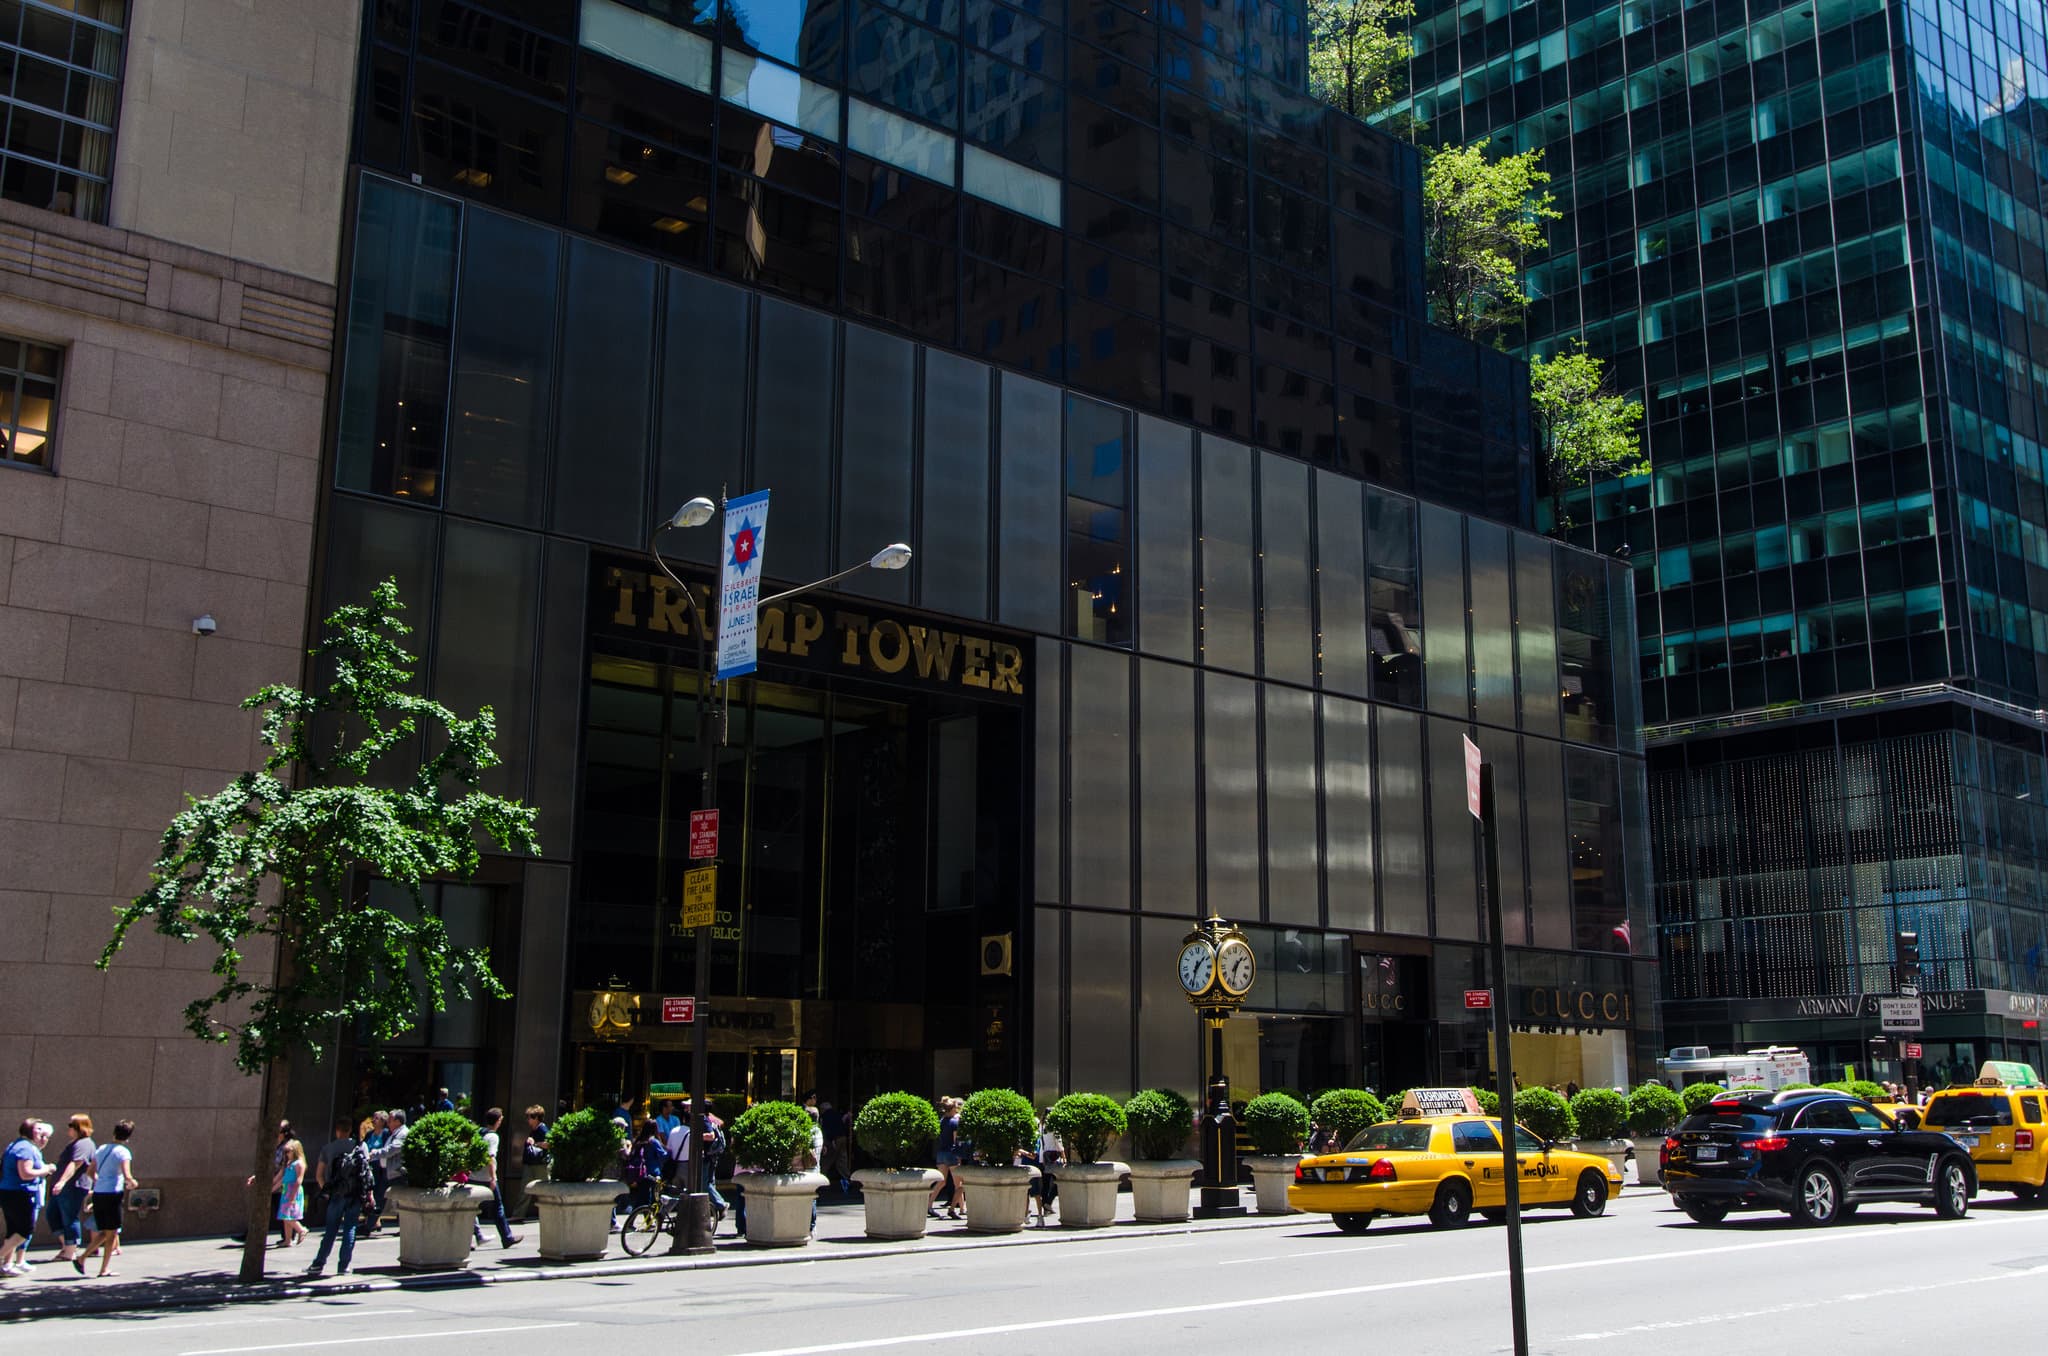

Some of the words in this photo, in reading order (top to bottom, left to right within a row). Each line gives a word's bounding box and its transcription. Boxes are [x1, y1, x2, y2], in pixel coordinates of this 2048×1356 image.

[723, 585, 757, 607] ISRAEL
[833, 609, 1023, 696] TOWER
[689, 873, 710, 885] CLEAR
[686, 886, 699, 896] FIRE
[699, 884, 713, 894] LANE
[684, 903, 713, 914] EMERGENCY
[686, 912, 711, 924] VEHICLES
[710, 926, 743, 940] BLIC
[1361, 992, 1406, 1011] UCC
[1530, 987, 1630, 1022] GUCCI
[1797, 998, 1855, 1015] ARMANI
[1524, 1168, 1537, 1177] NYC
[1537, 1162, 1560, 1178] TAXI
